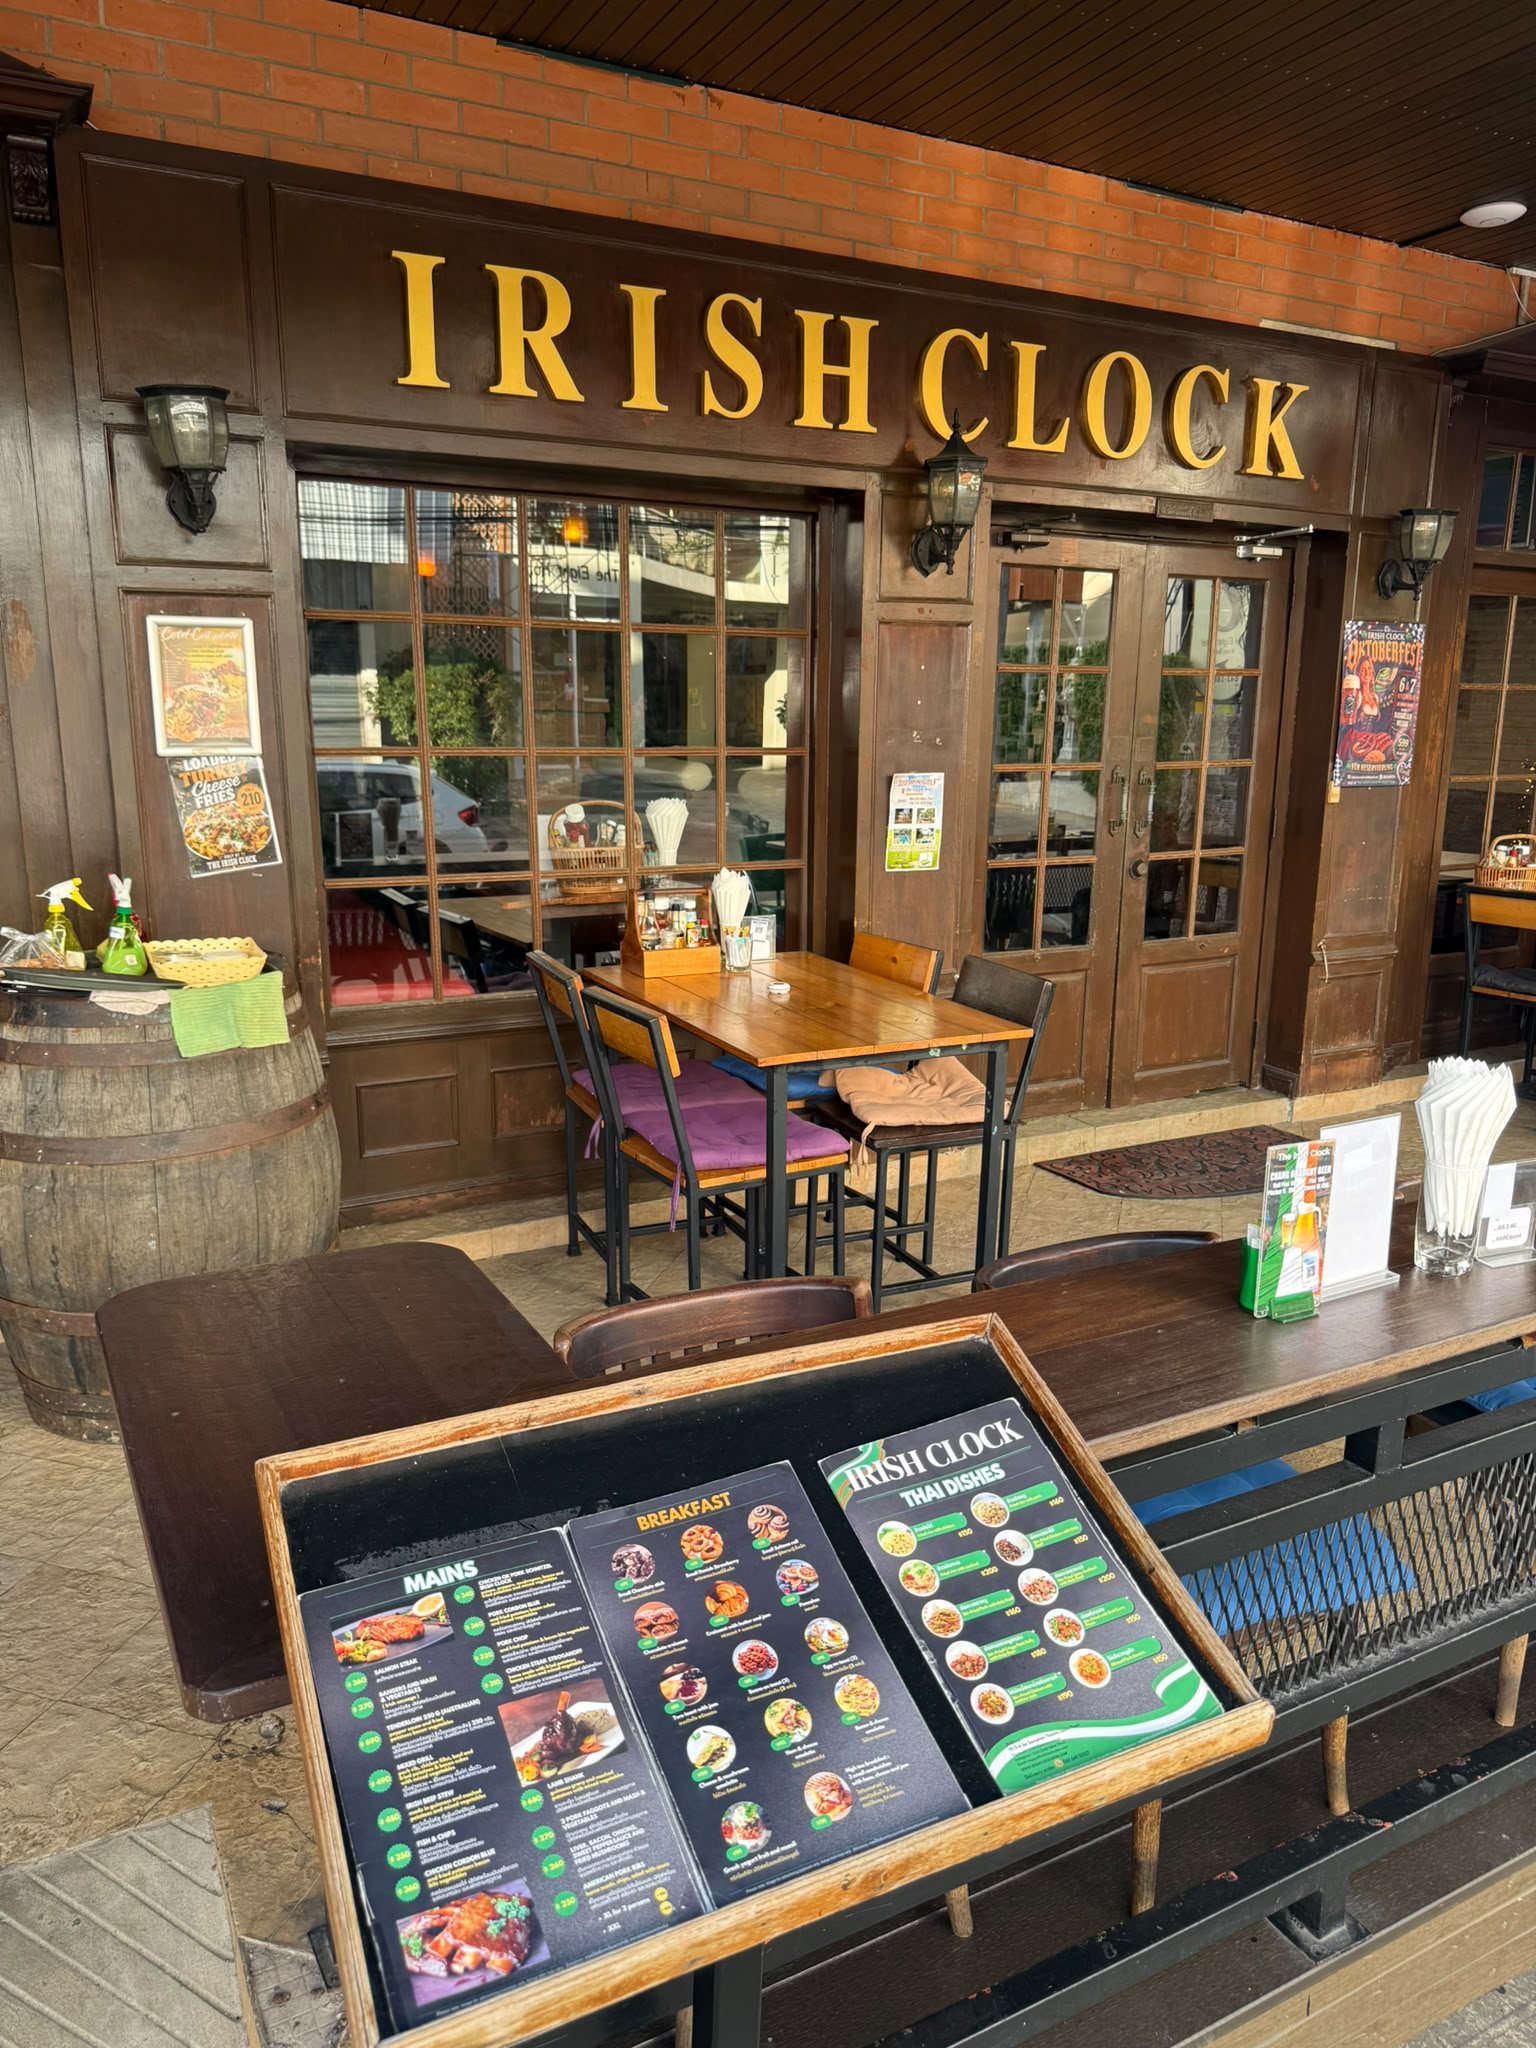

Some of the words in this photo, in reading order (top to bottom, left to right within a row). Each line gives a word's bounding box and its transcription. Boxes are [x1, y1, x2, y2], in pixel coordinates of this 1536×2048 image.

[391, 249, 879, 433] IRISH
[920, 327, 1311, 480] CLOCK
[1368, 632, 1386, 640] IRISH
[1386, 632, 1406, 641] CLOCK
[1346, 638, 1424, 673] OKTOBERFEST
[1399, 676, 1406, 692] 6
[1410, 678, 1417, 694] 7
[179, 759, 248, 787] TURKEY
[182, 755, 237, 771] LOADED
[191, 775, 242, 797] Cheese
[195, 788, 236, 809] FRIES
[240, 791, 261, 807] 210
[206, 861, 221, 870] THE
[221, 858, 238, 868] IRISH
[238, 855, 258, 865] CLOCK
[1278, 1152, 1292, 1162] The
[1310, 1147, 1331, 1157] Clock
[1270, 1170, 1290, 1181] CHANG
[1317, 1165, 1332, 1175] BEER
[842, 1447, 928, 1495] IRISH
[920, 1416, 1025, 1469] CLOCK
[899, 1481, 946, 1510] THAI
[940, 1461, 1008, 1496] DISHES
[634, 1490, 735, 1531] BREAKFAST
[401, 1558, 479, 1595] MAINS
[373, 1663, 399, 1675] SALMON
[399, 1658, 418, 1668] STEAK
[396, 1759, 416, 1771] MIXED
[416, 1753, 434, 1764] GRILL
[547, 1778, 564, 1790] LAMB
[563, 1771, 585, 1784] SHANK
[437, 1788, 455, 1800] STEW
[565, 1811, 583, 1823] PORK
[610, 1797, 623, 1807] AND
[561, 1812, 598, 1831] VEGETABLES
[415, 1836, 431, 1848] FISH
[430, 1835, 437, 1843] &
[436, 1828, 456, 1841] CHIPS
[423, 1862, 453, 1879] CHICKEN
[452, 1852, 480, 1868] CORDON
[479, 1846, 496, 1859] BLUE
[582, 1872, 614, 1890] AMERICAN
[614, 1865, 632, 1877] PORK
